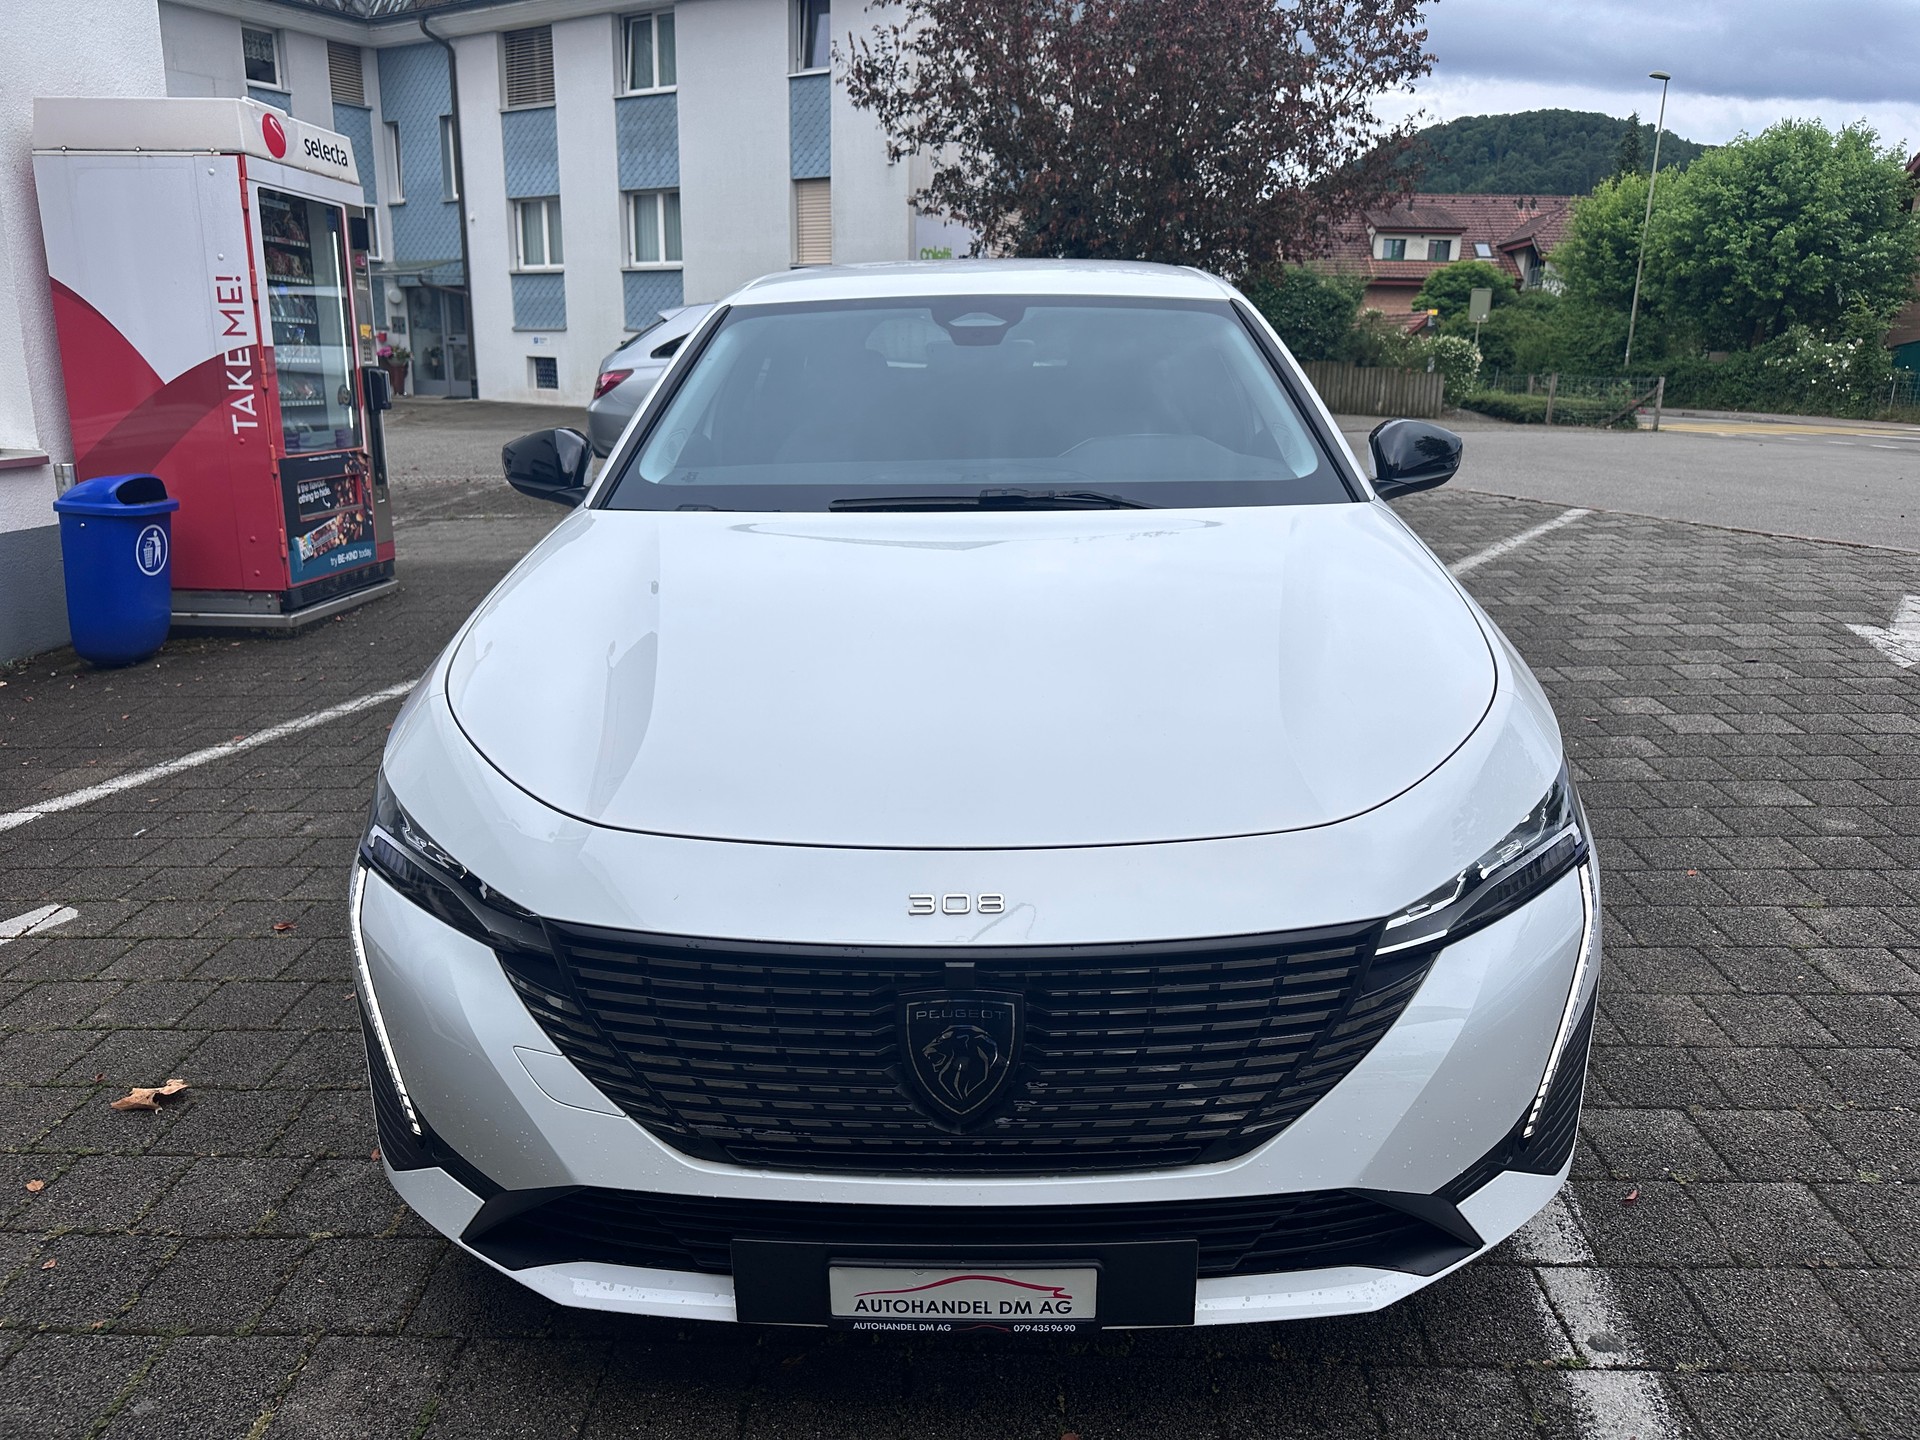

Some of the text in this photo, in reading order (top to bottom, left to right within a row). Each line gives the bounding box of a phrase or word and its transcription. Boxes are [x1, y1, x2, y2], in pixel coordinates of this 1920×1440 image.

[304, 138, 348, 167] selecta
[215, 275, 258, 435] TAKE ME!
[314, 490, 319, 499] to
[337, 549, 358, 564] BE-KIND
[908, 893, 1005, 915] 308
[916, 1009, 1005, 1020] PEUGEOT
[854, 1298, 1073, 1315] AUTOHANDEL DM AG
[853, 1322, 917, 1331] AUTOHANDEL
[919, 1323, 935, 1331] DM
[936, 1323, 952, 1332] AG
[1013, 1324, 1032, 1332] 079
[1032, 1324, 1050, 1332] 435
